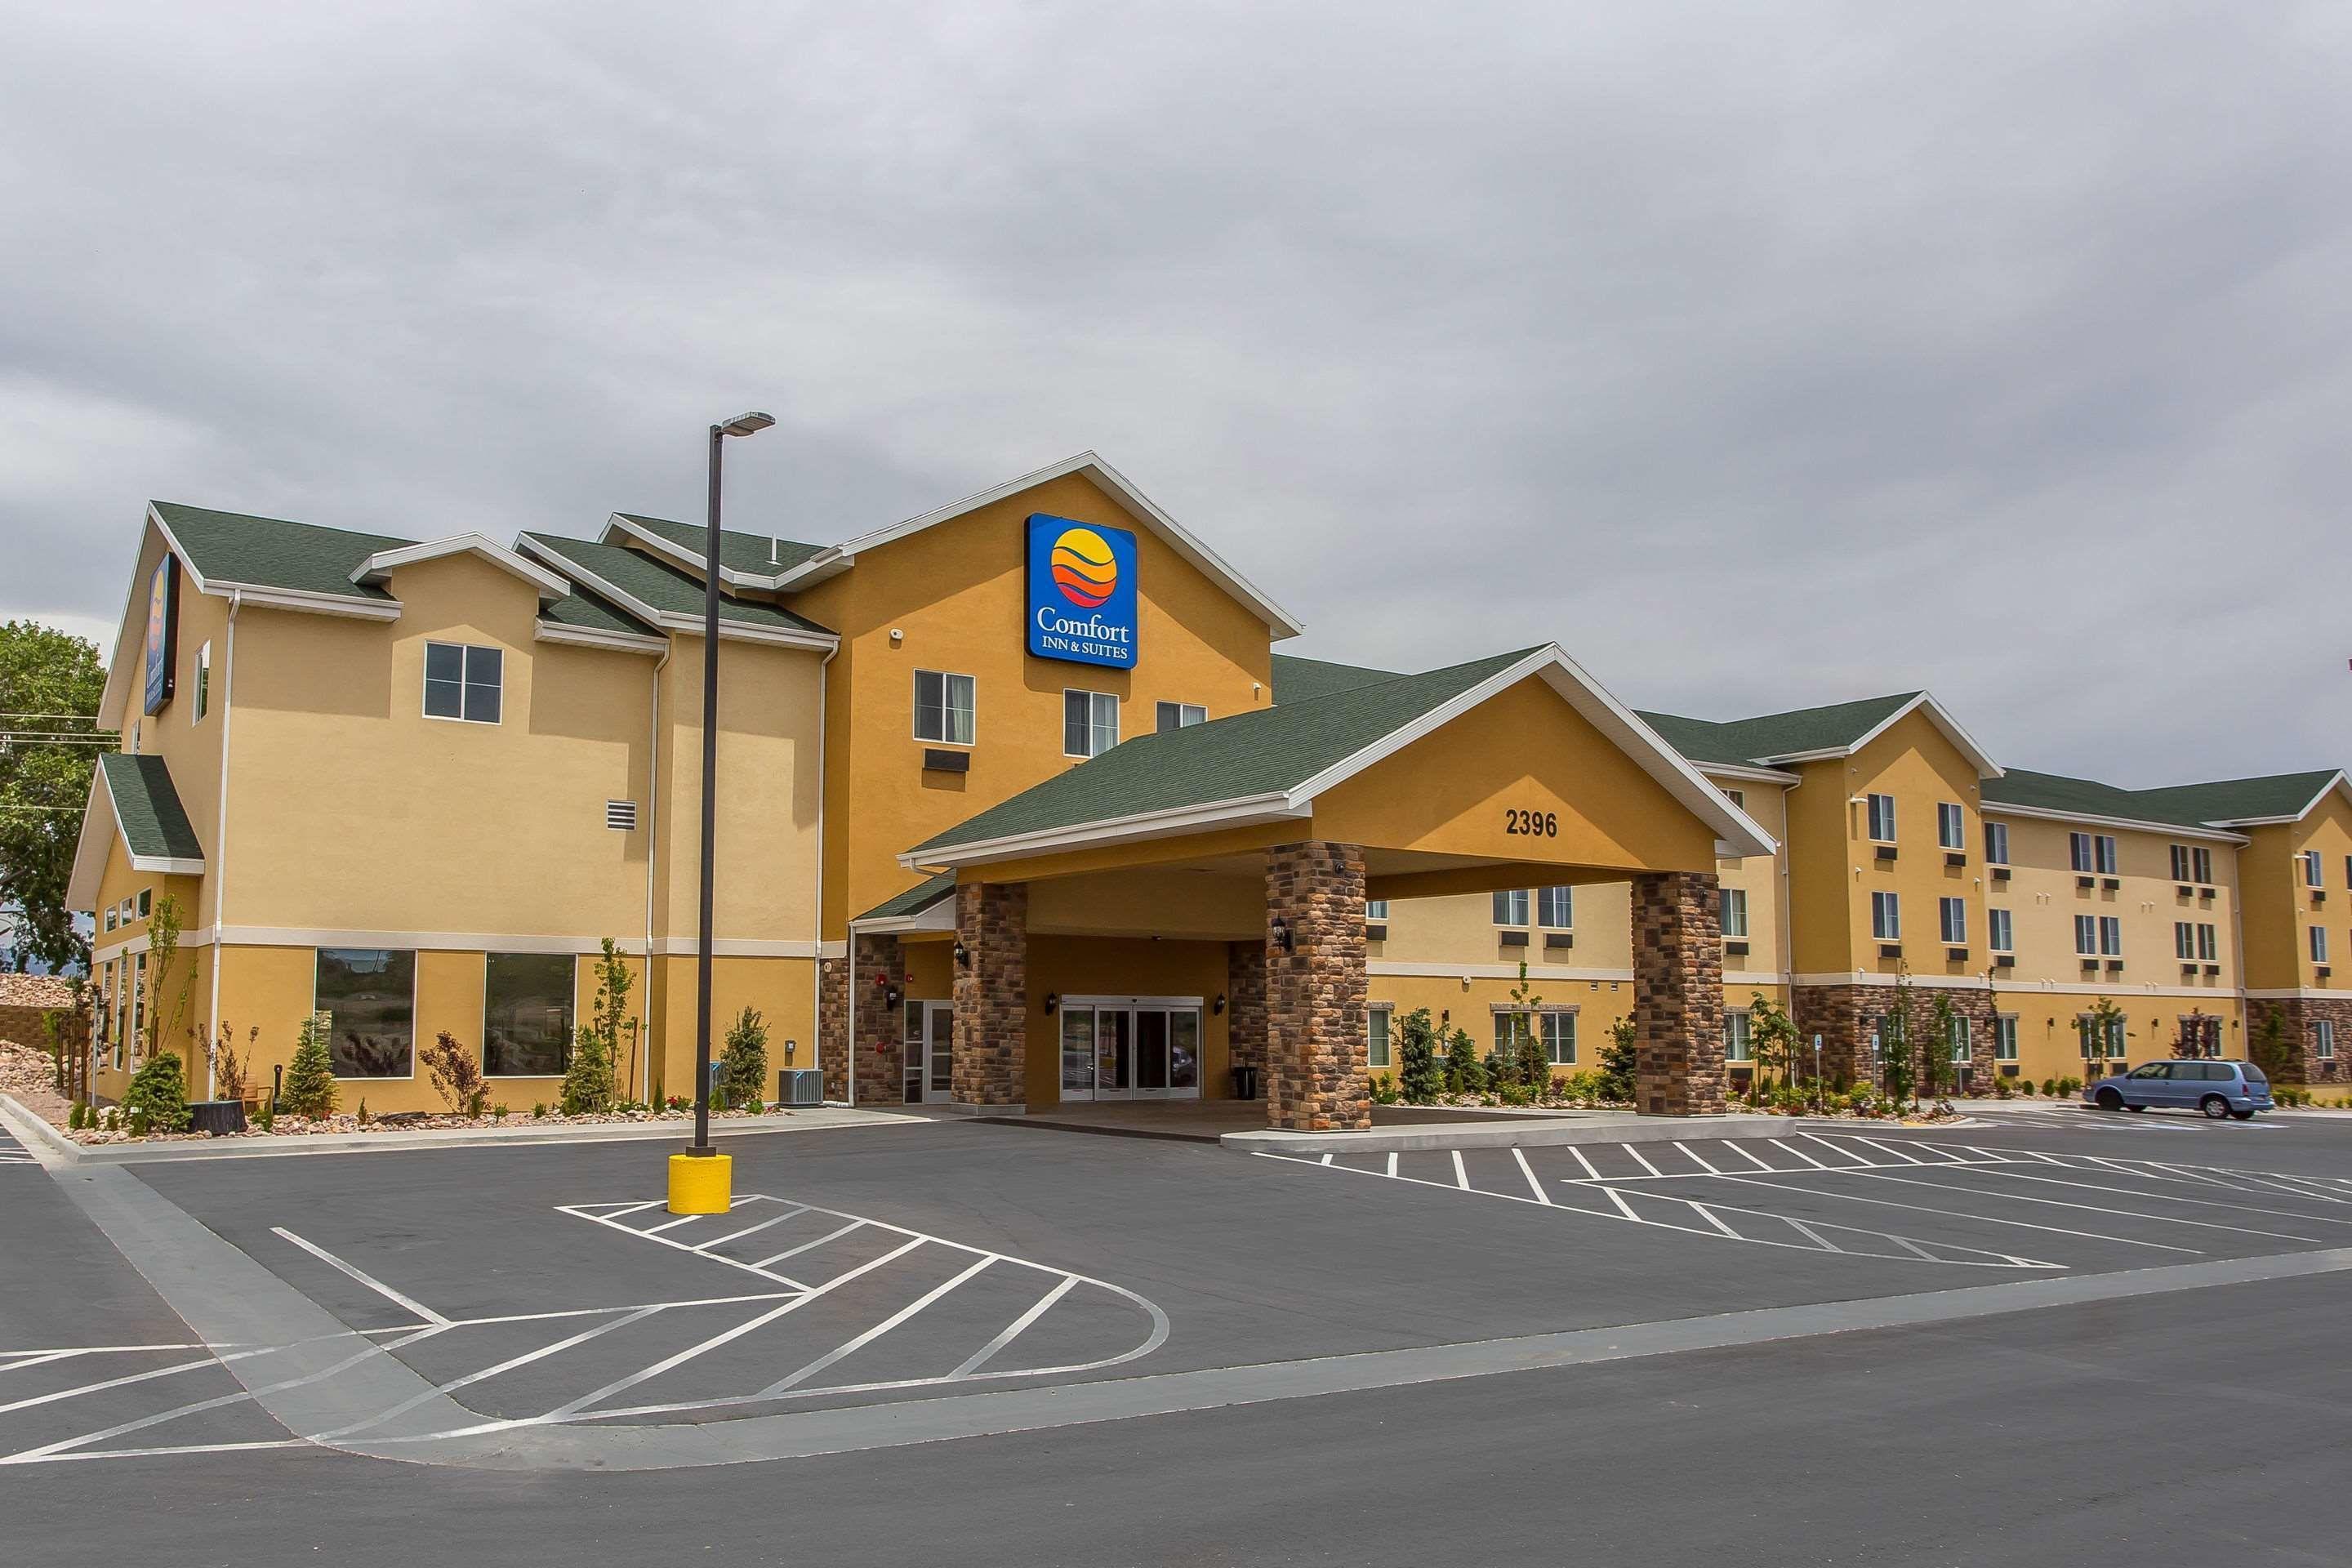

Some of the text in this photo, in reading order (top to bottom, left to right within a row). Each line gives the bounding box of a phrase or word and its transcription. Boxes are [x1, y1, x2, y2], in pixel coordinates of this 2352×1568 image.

[1037, 607, 1129, 643] Comfort
[1042, 635, 1128, 659] INN & SUITES
[1506, 809, 1557, 838] 2396
